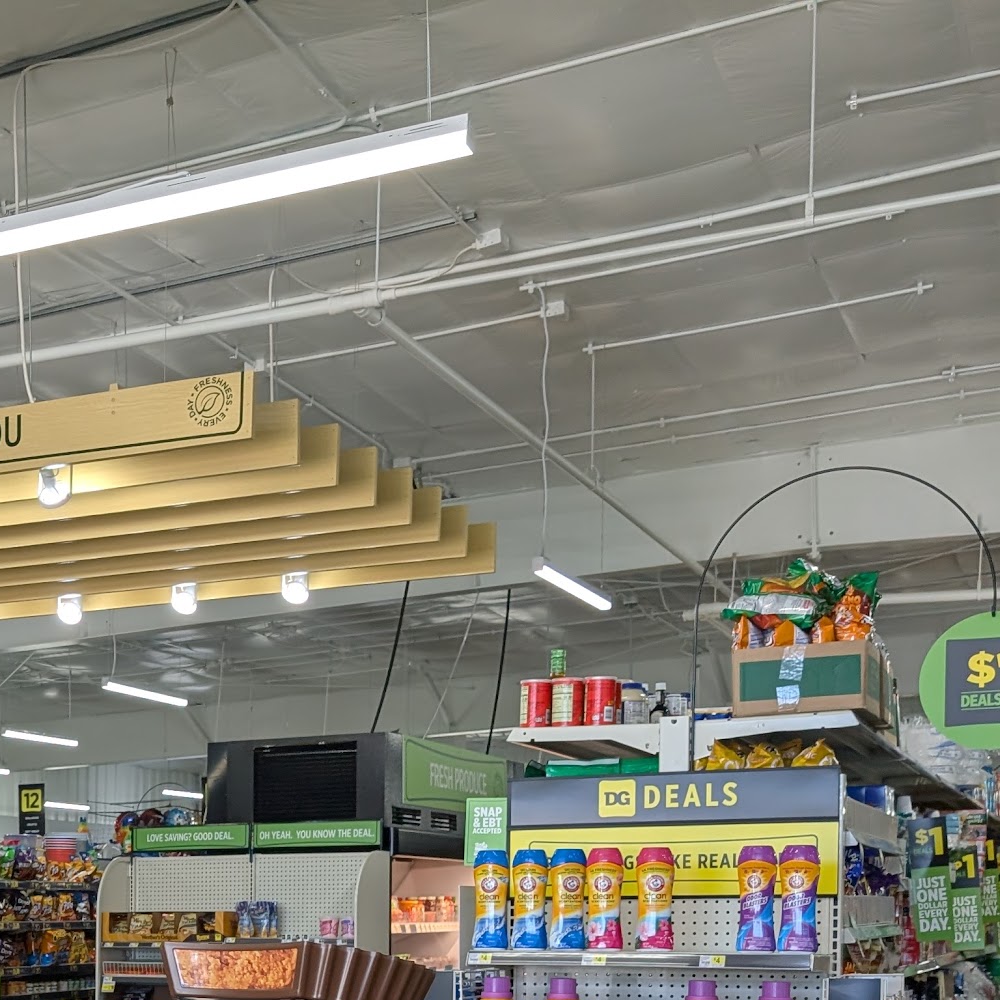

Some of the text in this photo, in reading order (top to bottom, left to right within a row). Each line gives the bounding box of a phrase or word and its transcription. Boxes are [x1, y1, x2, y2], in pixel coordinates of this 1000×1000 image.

[194, 376, 233, 406] FRESHNESS
[187, 399, 196, 418] DAY
[198, 412, 226, 427] EVERY
[430, 762, 488, 796] FRESH PRODUCE
[24, 792, 40, 808] 12
[604, 782, 738, 809] DG DEALS
[474, 806, 502, 818] SNAP
[472, 816, 502, 828] & EBT
[146, 831, 235, 842] LOVE SAVING? GOOD DEAL.
[260, 828, 375, 840] OH YEAH. YOU KNOW THE DEAL.
[472, 826, 502, 835] ACCEPTED
[914, 826, 944, 856] $1
[917, 876, 946, 890] JUST
[917, 888, 947, 902] ONE
[953, 896, 976, 907] JUST
[918, 901, 948, 910] DOLLAR
[952, 906, 978, 917] ONE
[918, 908, 948, 918] EVERY
[920, 917, 952, 932] DAY.
[954, 916, 978, 924] DOLLAR
[954, 922, 978, 931] EVERY
[954, 929, 981, 943] DAY.
